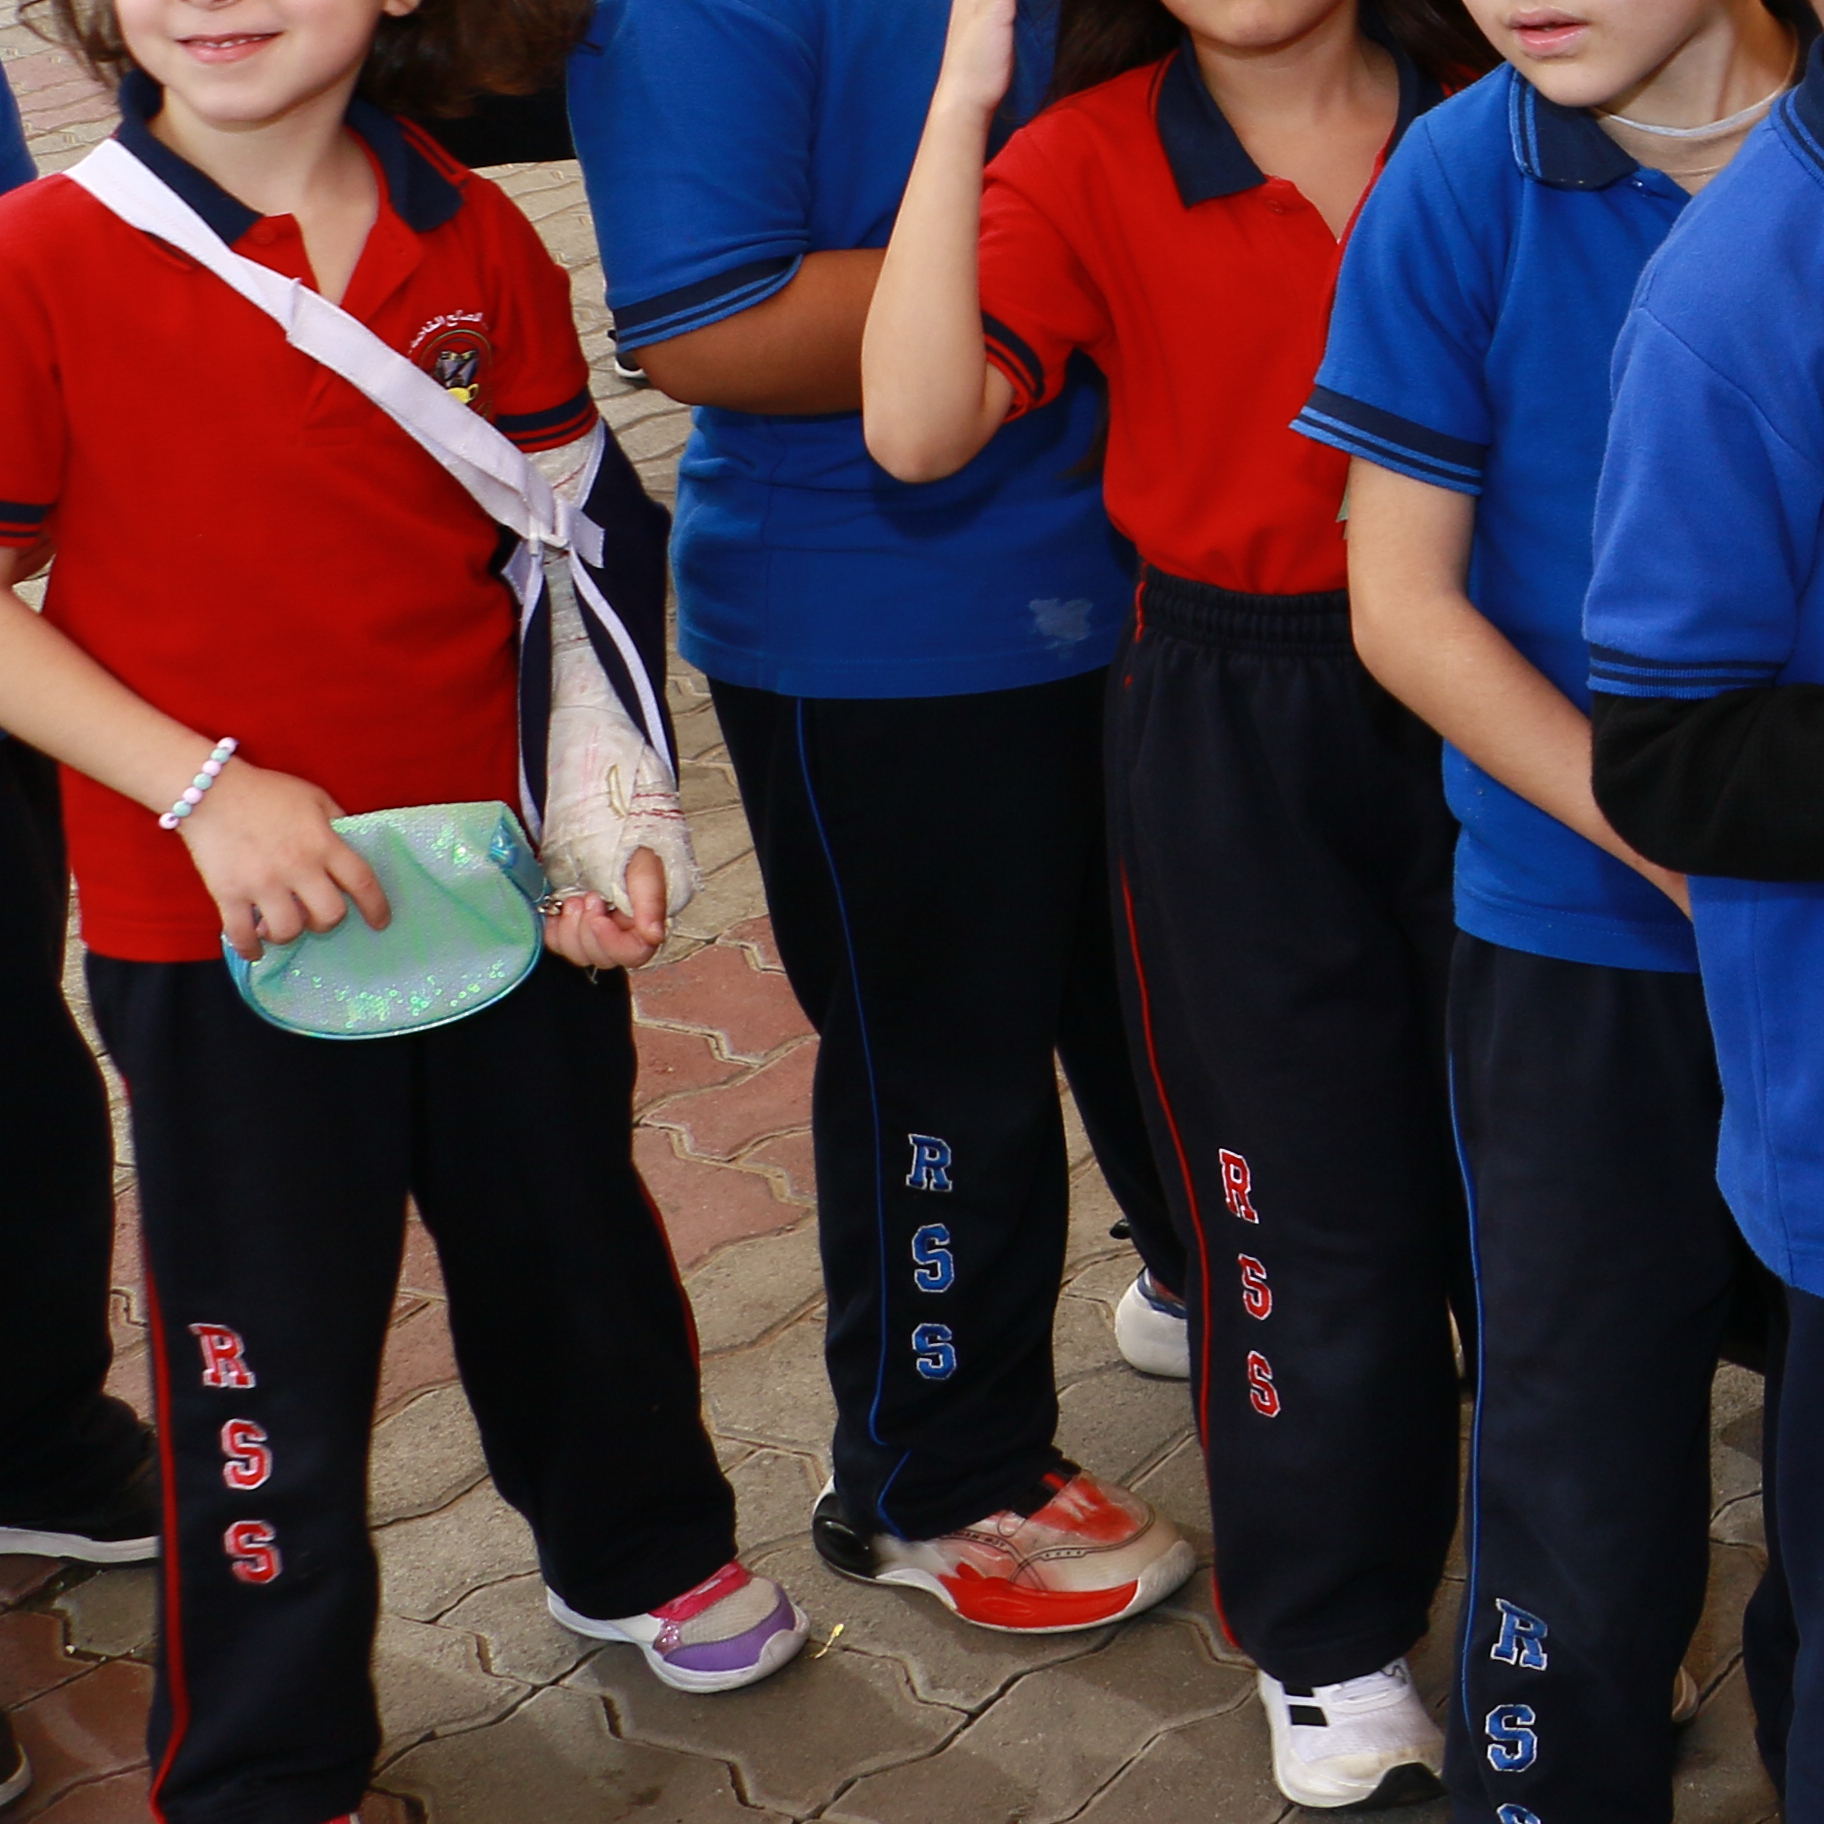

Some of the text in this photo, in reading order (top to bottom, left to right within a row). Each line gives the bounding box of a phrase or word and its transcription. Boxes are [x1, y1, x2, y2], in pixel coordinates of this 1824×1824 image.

[906, 1133, 956, 1381] RSS
[1218, 1148, 1282, 1419] RSS
[190, 1323, 283, 1584] RSS
